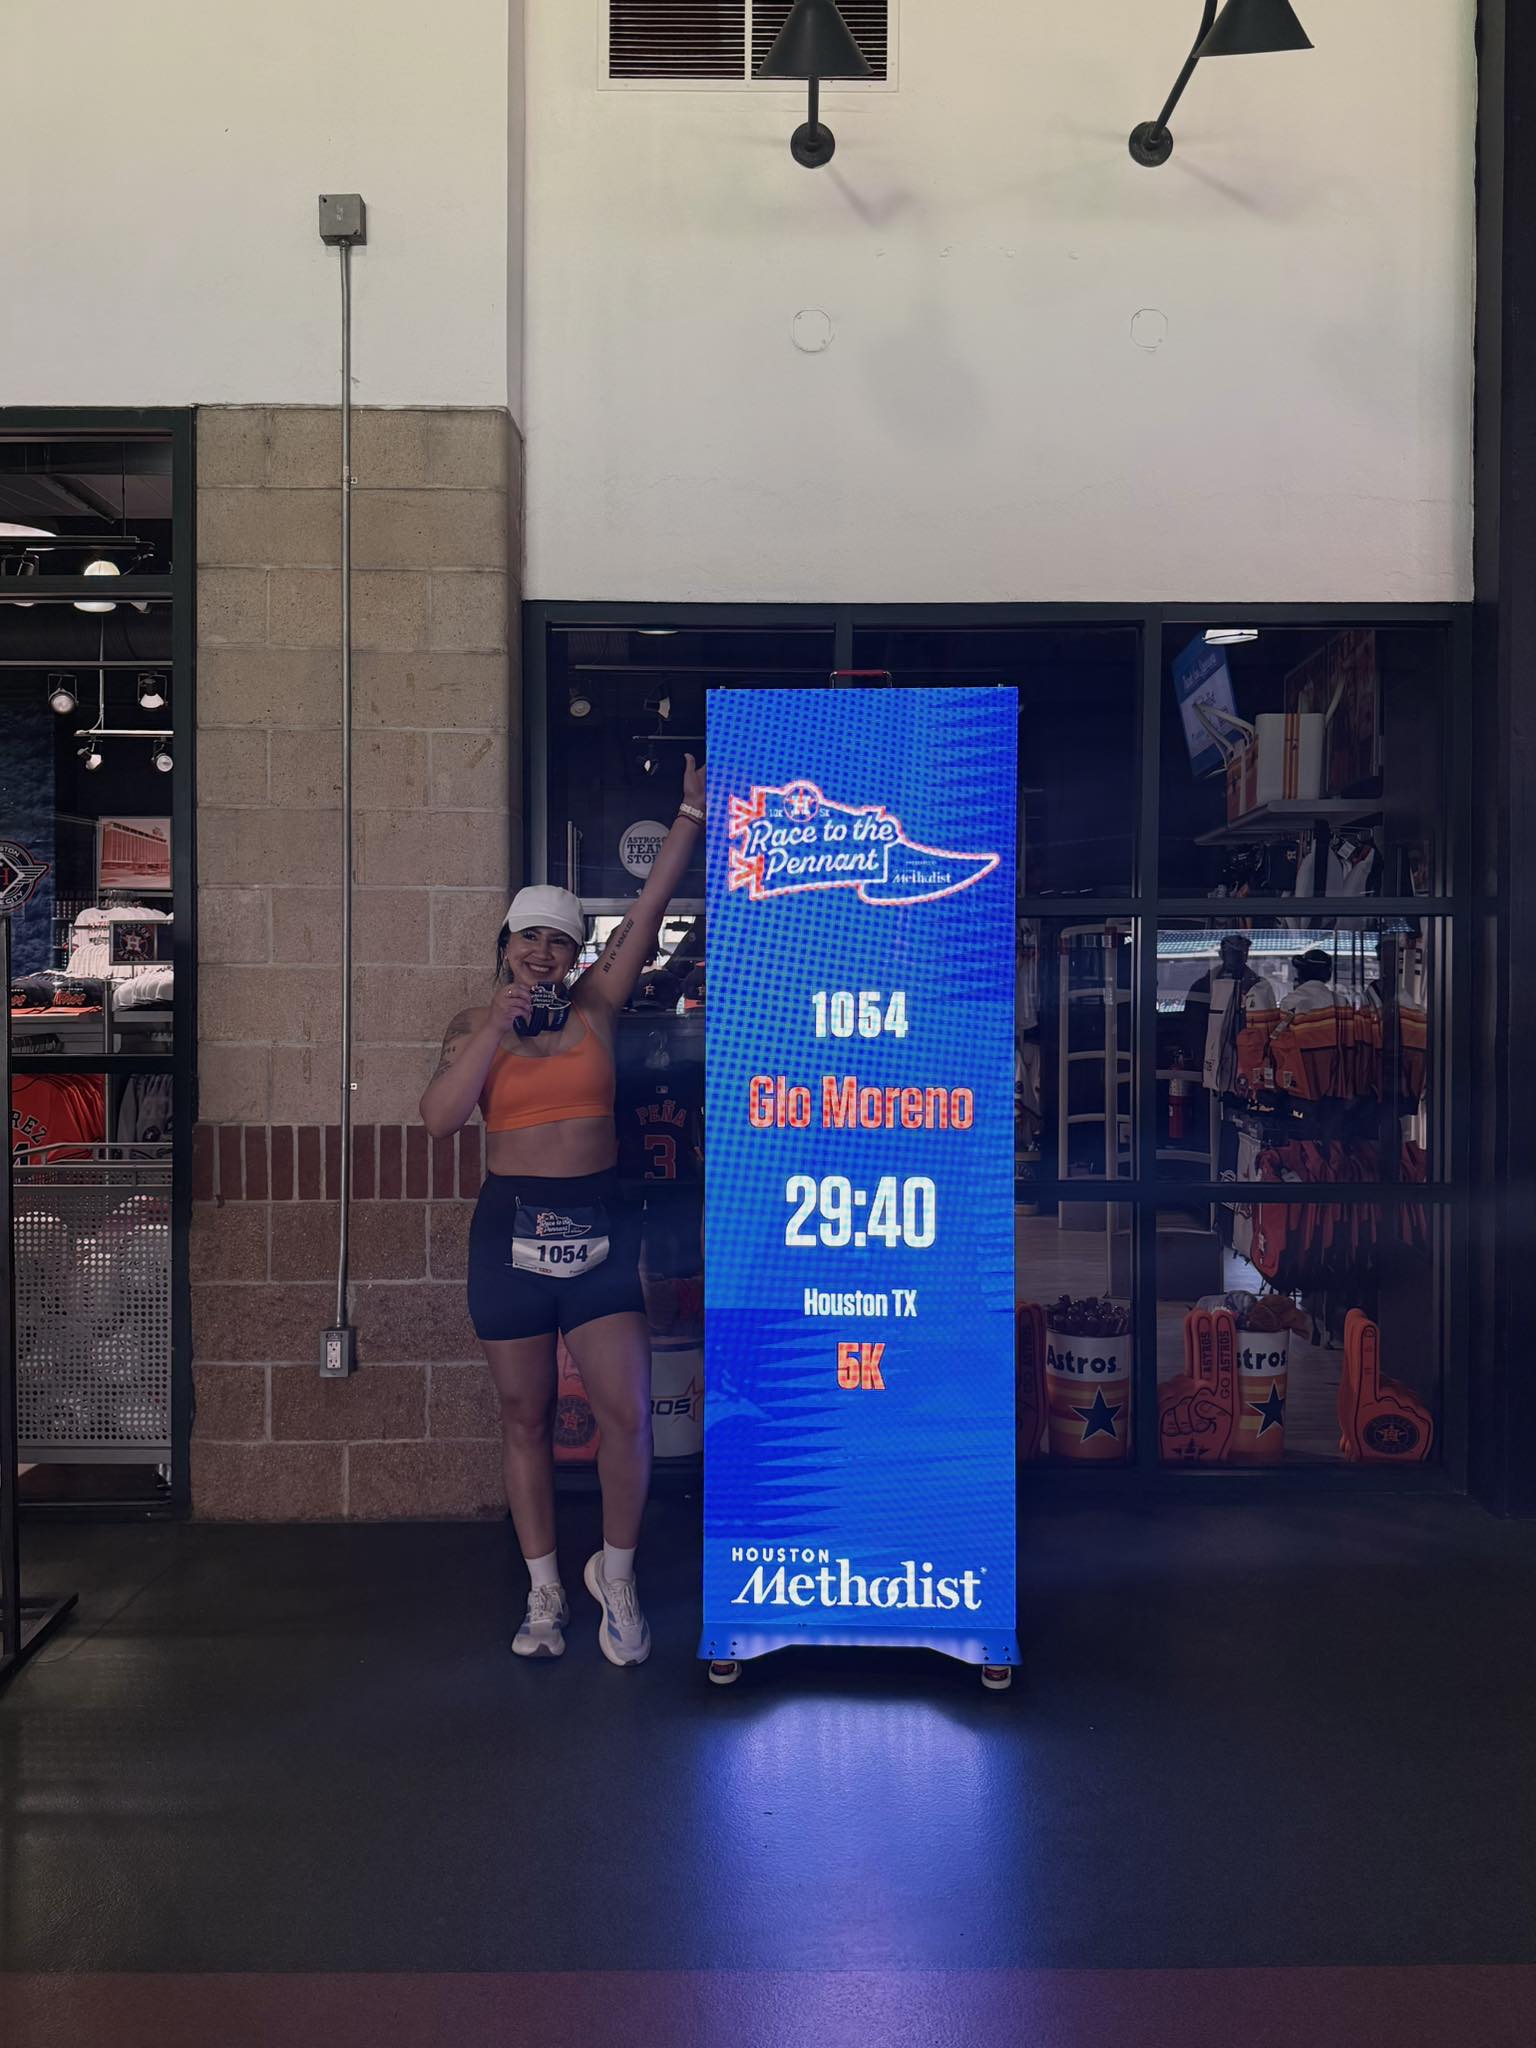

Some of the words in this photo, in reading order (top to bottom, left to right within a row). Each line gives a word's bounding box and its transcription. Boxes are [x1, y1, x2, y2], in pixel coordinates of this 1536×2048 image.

[749, 820, 817, 854] Race
[823, 820, 848, 842] to
[853, 815, 894, 841] the
[765, 847, 880, 881] Pennant
[811, 990, 910, 1039] 1054
[748, 1074, 812, 1129] Glo
[821, 1074, 976, 1130] Moreno
[644, 1134, 677, 1180] 3
[784, 1174, 937, 1249] 29:40
[537, 1244, 588, 1264] 1054
[804, 1287, 888, 1317] Houston
[891, 1288, 918, 1317] TX
[836, 1341, 887, 1391] 5K
[1047, 1344, 1117, 1375] Astros
[1219, 1330, 1231, 1373] ASTROS
[731, 1547, 830, 1563] HOUSTON
[730, 1558, 983, 1611] Methodist
